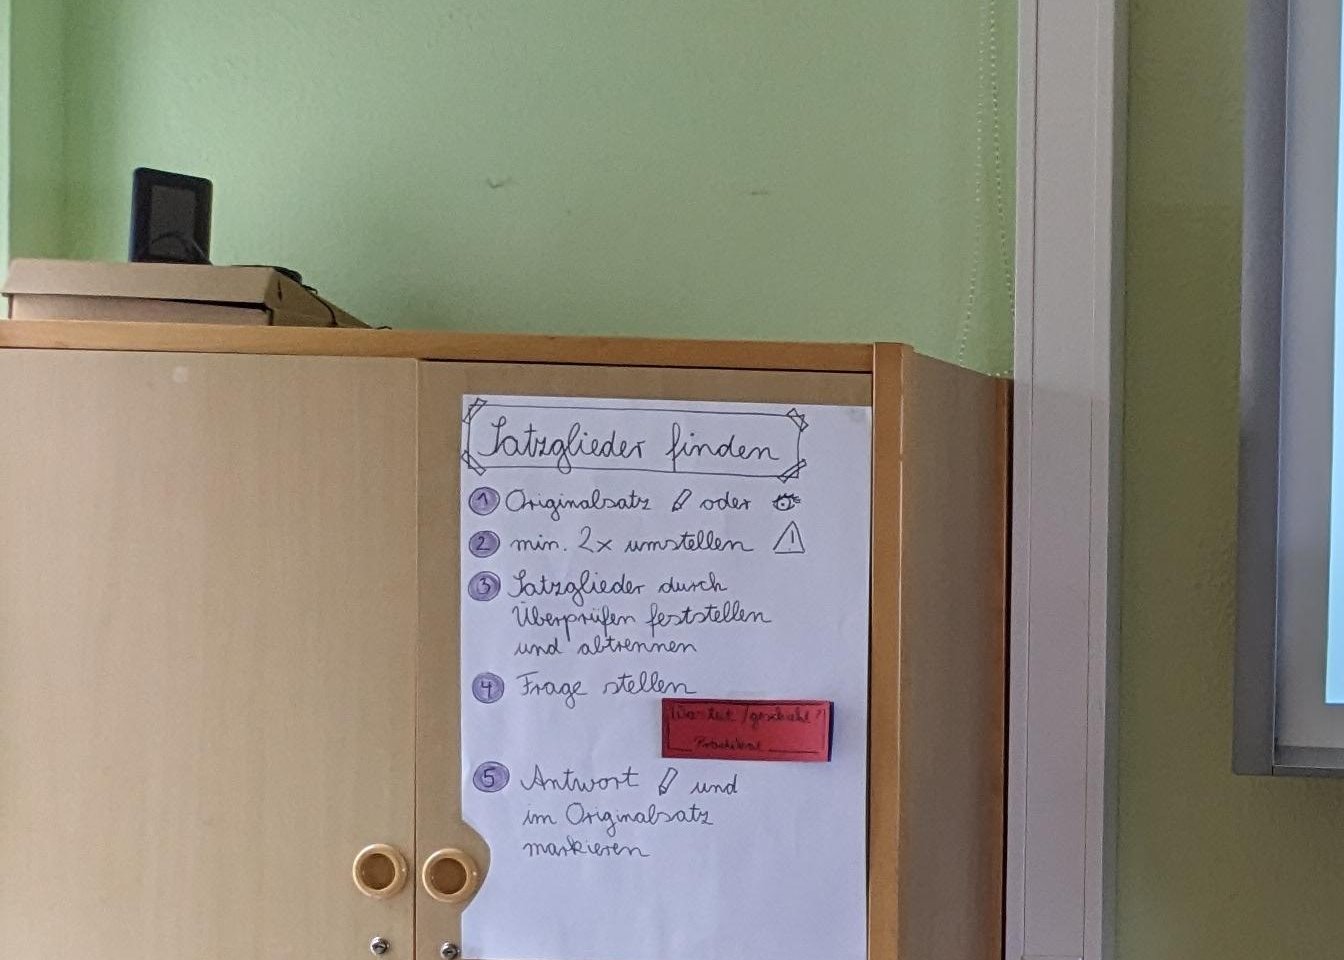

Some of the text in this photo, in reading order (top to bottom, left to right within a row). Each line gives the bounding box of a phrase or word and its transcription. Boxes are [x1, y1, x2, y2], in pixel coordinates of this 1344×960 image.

[477, 415, 780, 475] Satzglieder finden
[505, 488, 653, 522] Originalsatz
[699, 491, 753, 511] oder
[510, 534, 569, 552] min.
[578, 525, 613, 554] 2x
[624, 528, 755, 554] umstellen
[507, 570, 646, 608] Satzglieder
[657, 573, 728, 595] durch
[511, 600, 772, 643] Überprüfen feststellen
[514, 633, 697, 657] und abtrennen
[516, 670, 587, 708] Frage
[603, 671, 697, 696] stellen
[520, 765, 640, 794] Antwort
[690, 774, 739, 796] und
[522, 800, 714, 837] im Originalsatz
[522, 836, 650, 858] markieren
